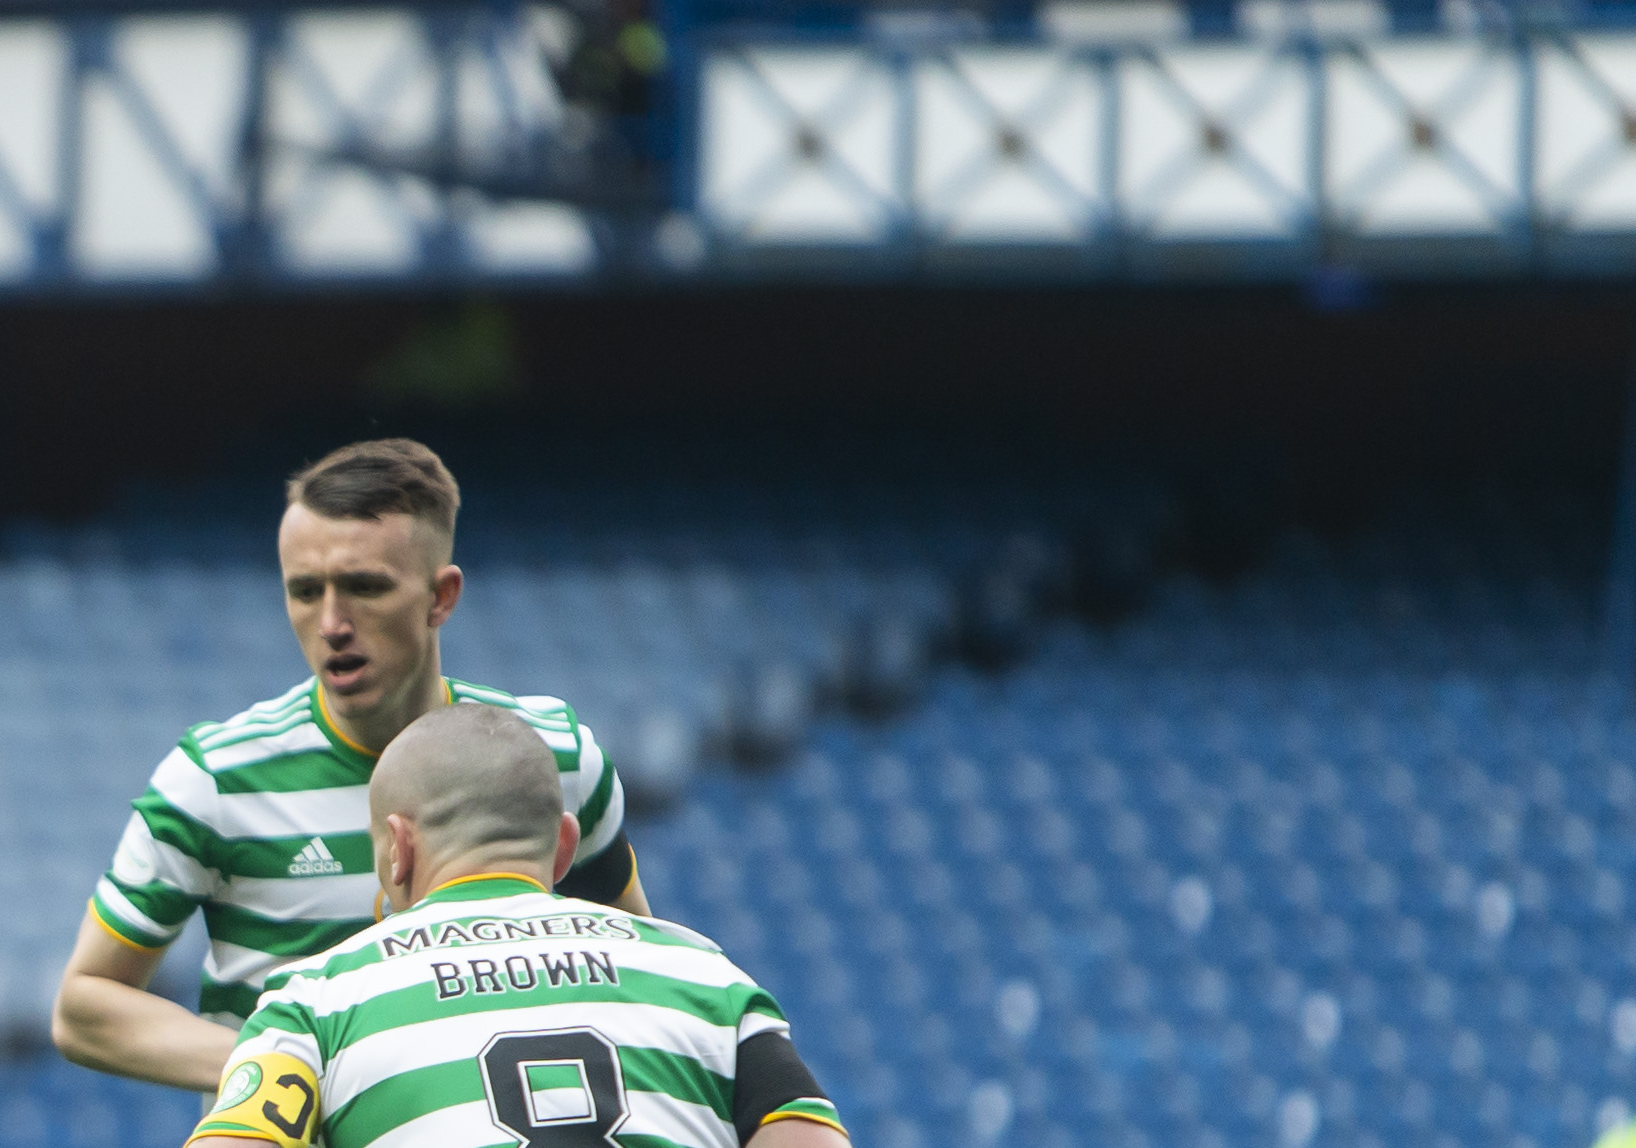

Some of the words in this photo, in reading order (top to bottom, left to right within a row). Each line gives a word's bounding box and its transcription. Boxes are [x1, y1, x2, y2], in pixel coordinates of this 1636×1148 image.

[288, 859, 344, 876] adidas
[380, 915, 638, 959] MAGNERS
[429, 949, 620, 1000] BROWN
